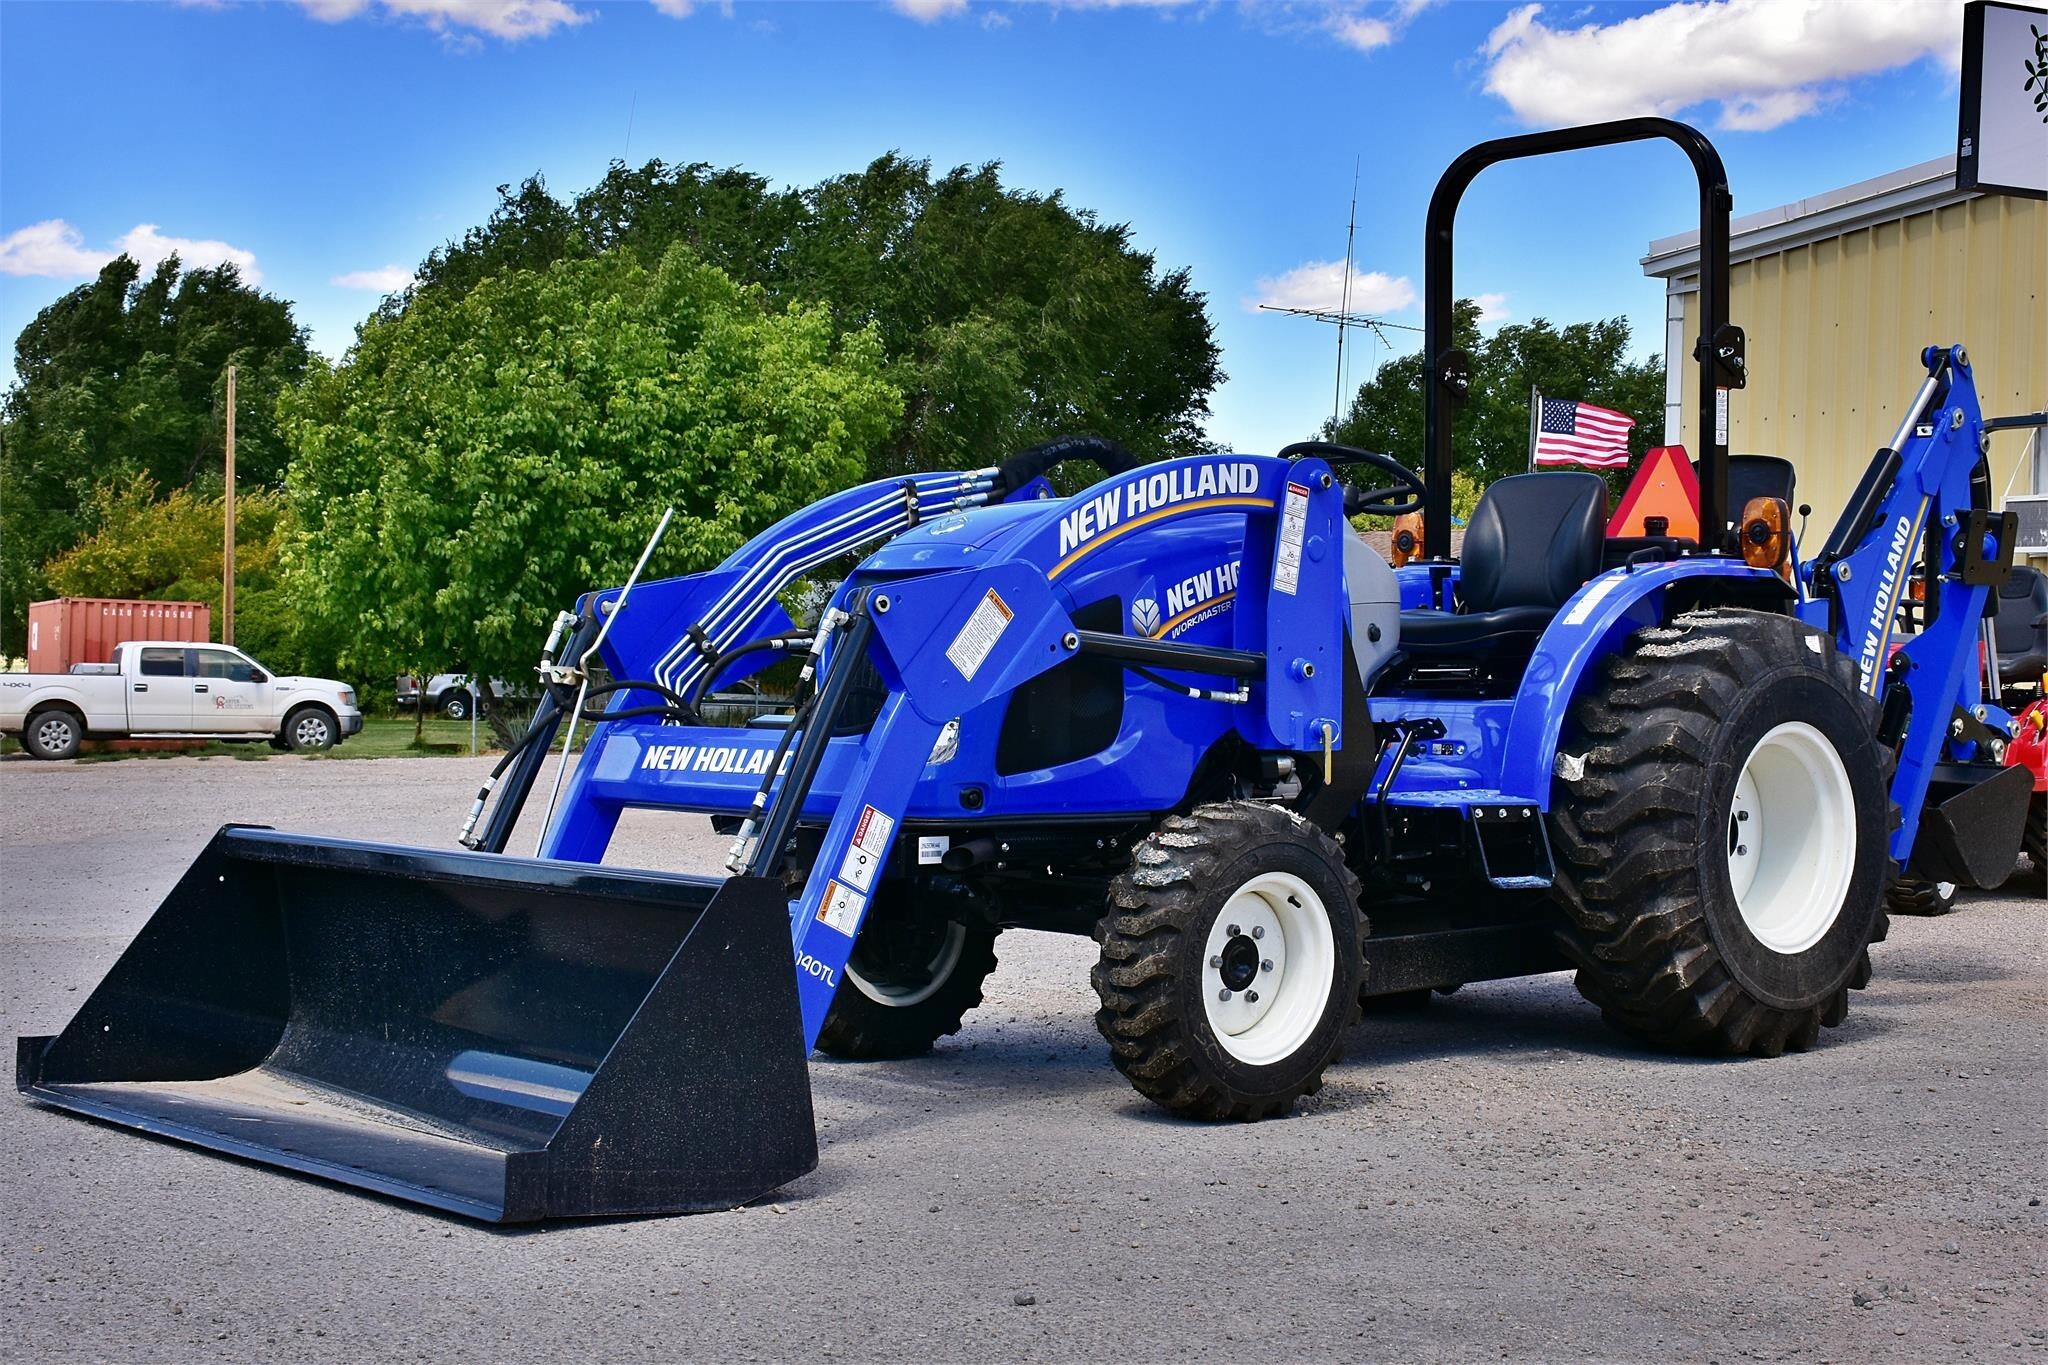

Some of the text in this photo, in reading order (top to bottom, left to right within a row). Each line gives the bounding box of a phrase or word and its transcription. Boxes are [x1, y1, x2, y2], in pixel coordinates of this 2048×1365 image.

[1060, 463, 1259, 558] NEW HOLLAND
[1166, 569, 1213, 617] NEW
[1859, 516, 1911, 693] NEW HOLLAND
[1171, 601, 1232, 639] WORKMASTER
[641, 745, 696, 771] NEW
[858, 809, 873, 837] DANGER
[796, 950, 835, 988] 140TL
